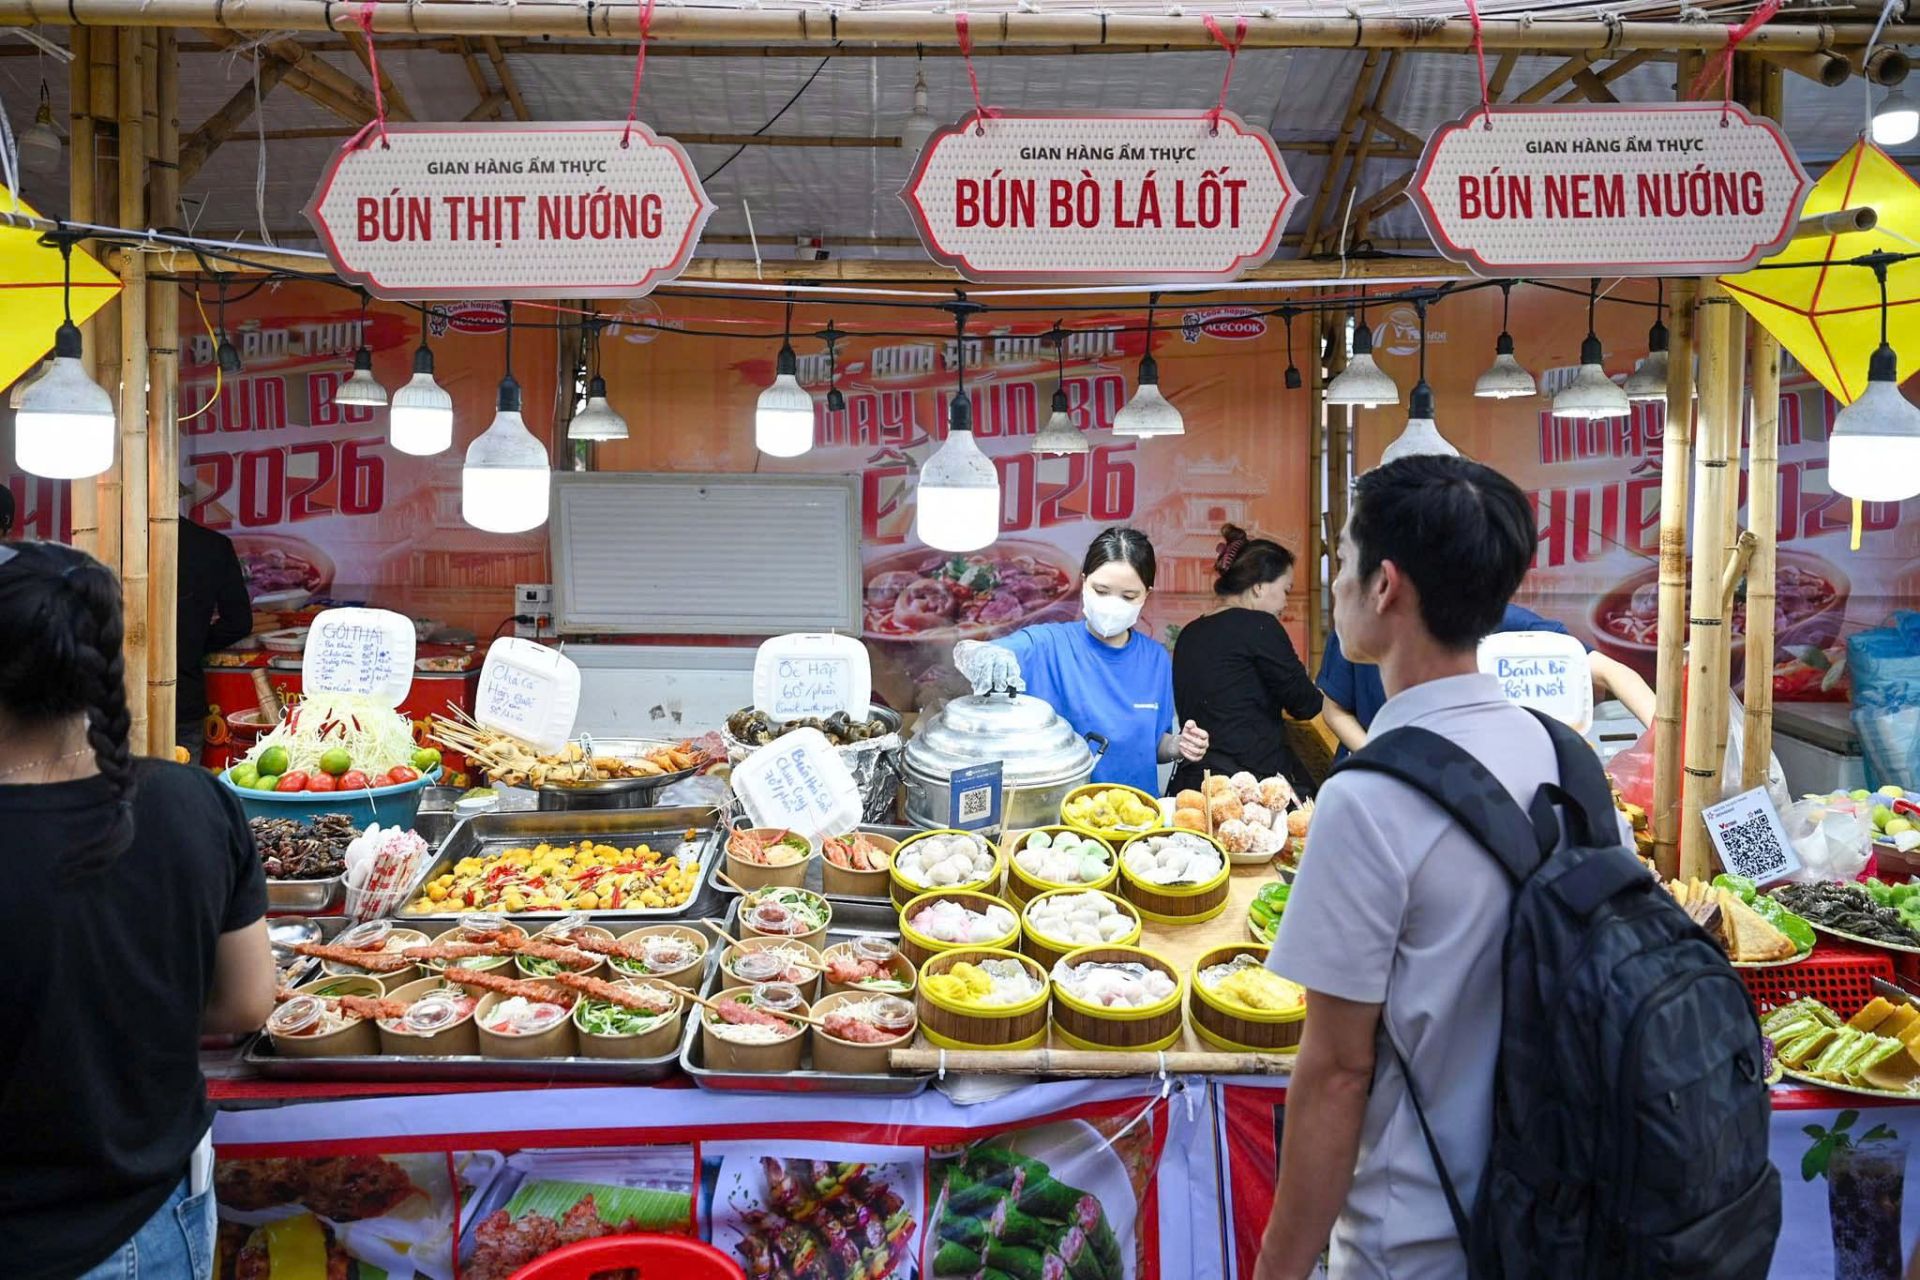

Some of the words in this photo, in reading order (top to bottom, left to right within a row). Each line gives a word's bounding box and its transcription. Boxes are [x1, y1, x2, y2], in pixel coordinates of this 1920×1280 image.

[427, 161, 470, 175] GIAN
[475, 159, 524, 175] HÀNG
[528, 158, 555, 174] ẨM
[561, 159, 607, 177] THỰC
[1020, 146, 1062, 161] GIAN
[1066, 145, 1115, 161] HÀNG
[1118, 143, 1146, 161] ẨM
[1151, 146, 1196, 164] THỰC
[1525, 140, 1567, 154] GIAN
[1572, 138, 1621, 154] HÀNG
[1625, 136, 1652, 153] ẨM
[1657, 137, 1704, 155] THỰC
[357, 187, 432, 242] BÚN
[442, 195, 526, 248] THỊT
[537, 185, 663, 241] NƯỚNG
[955, 169, 1036, 229] BÚN
[1049, 169, 1101, 229] BÒ
[1113, 169, 1163, 229] LÁ
[1175, 166, 1248, 229] LỐT
[1458, 166, 1533, 220] BÚN
[1544, 173, 1626, 219] NEM
[1636, 163, 1765, 218] NƯỚNG
[187, 437, 386, 530] 2026
[990, 442, 1138, 533] 026
